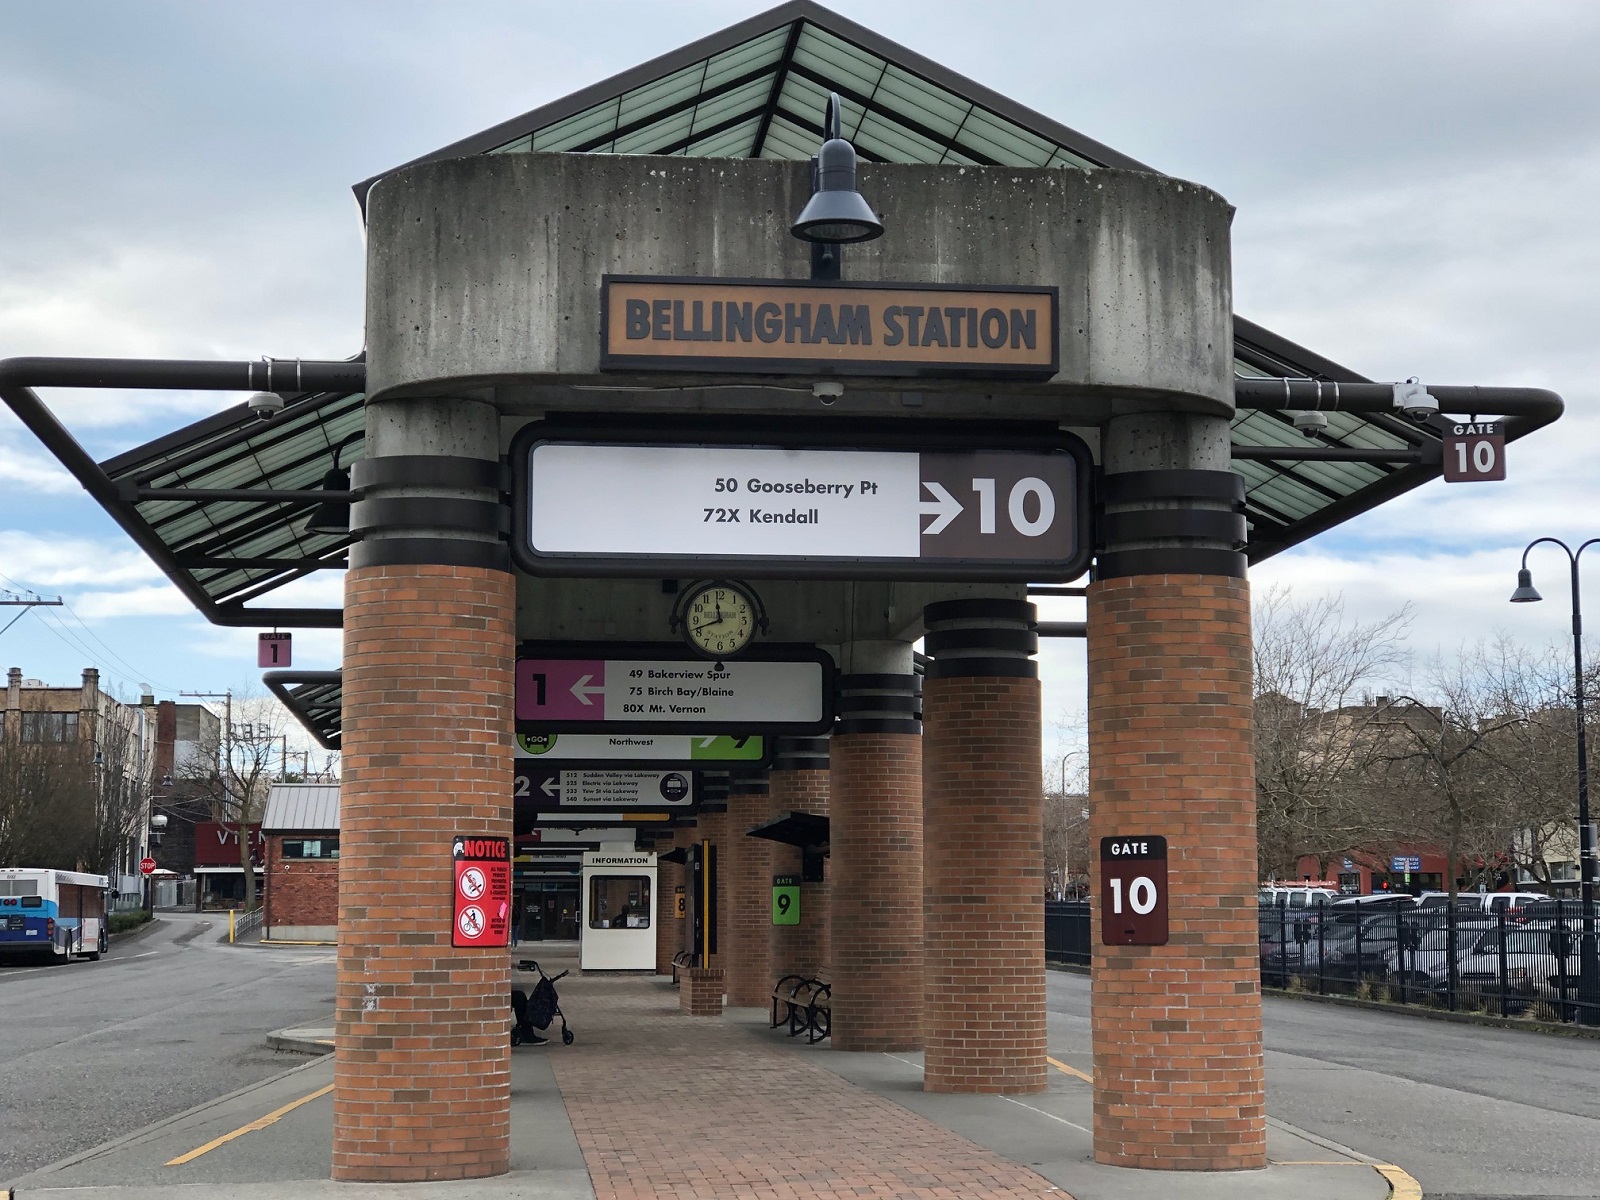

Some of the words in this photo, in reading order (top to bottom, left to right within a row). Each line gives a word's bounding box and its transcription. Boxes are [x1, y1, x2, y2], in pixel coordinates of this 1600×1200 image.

[625, 298, 873, 345] BELLINGHAM
[882, 304, 1037, 350] STATION
[1453, 424, 1494, 435] GATE
[1455, 440, 1495, 473] 10
[714, 478, 739, 493] 50
[747, 478, 854, 499] Gooseberry
[860, 481, 878, 495] Pt
[972, 476, 1056, 537] 10
[703, 508, 741, 523] 72X
[749, 509, 819, 524] Kendall
[703, 595, 709, 604] 11
[716, 591, 725, 600] 12
[695, 604, 703, 612] 10
[740, 605, 746, 613] 2
[693, 616, 699, 625] 9
[741, 617, 747, 625] 3
[696, 628, 702, 637] 8
[737, 629, 744, 637] 4
[704, 639, 709, 647] 7
[717, 642, 723, 650] 6
[729, 639, 735, 647] 5
[271, 644, 278, 663] 1
[629, 670, 643, 679] 49
[648, 670, 704, 679] Bakerview
[707, 671, 730, 681] Spur
[533, 673, 546, 706] 1
[629, 687, 643, 696] 75
[648, 687, 674, 696] Birch
[677, 687, 734, 698] Bay/Blaine
[623, 704, 644, 713] 80X
[649, 705, 666, 713] Mt.
[669, 705, 706, 713] Vernon
[609, 738, 654, 746] Northwest
[514, 775, 530, 797] 2
[464, 840, 506, 858] NOTICE
[1111, 843, 1148, 855] GATE
[1110, 876, 1157, 915] 10
[678, 898, 685, 912] 8
[778, 894, 791, 915] 9
